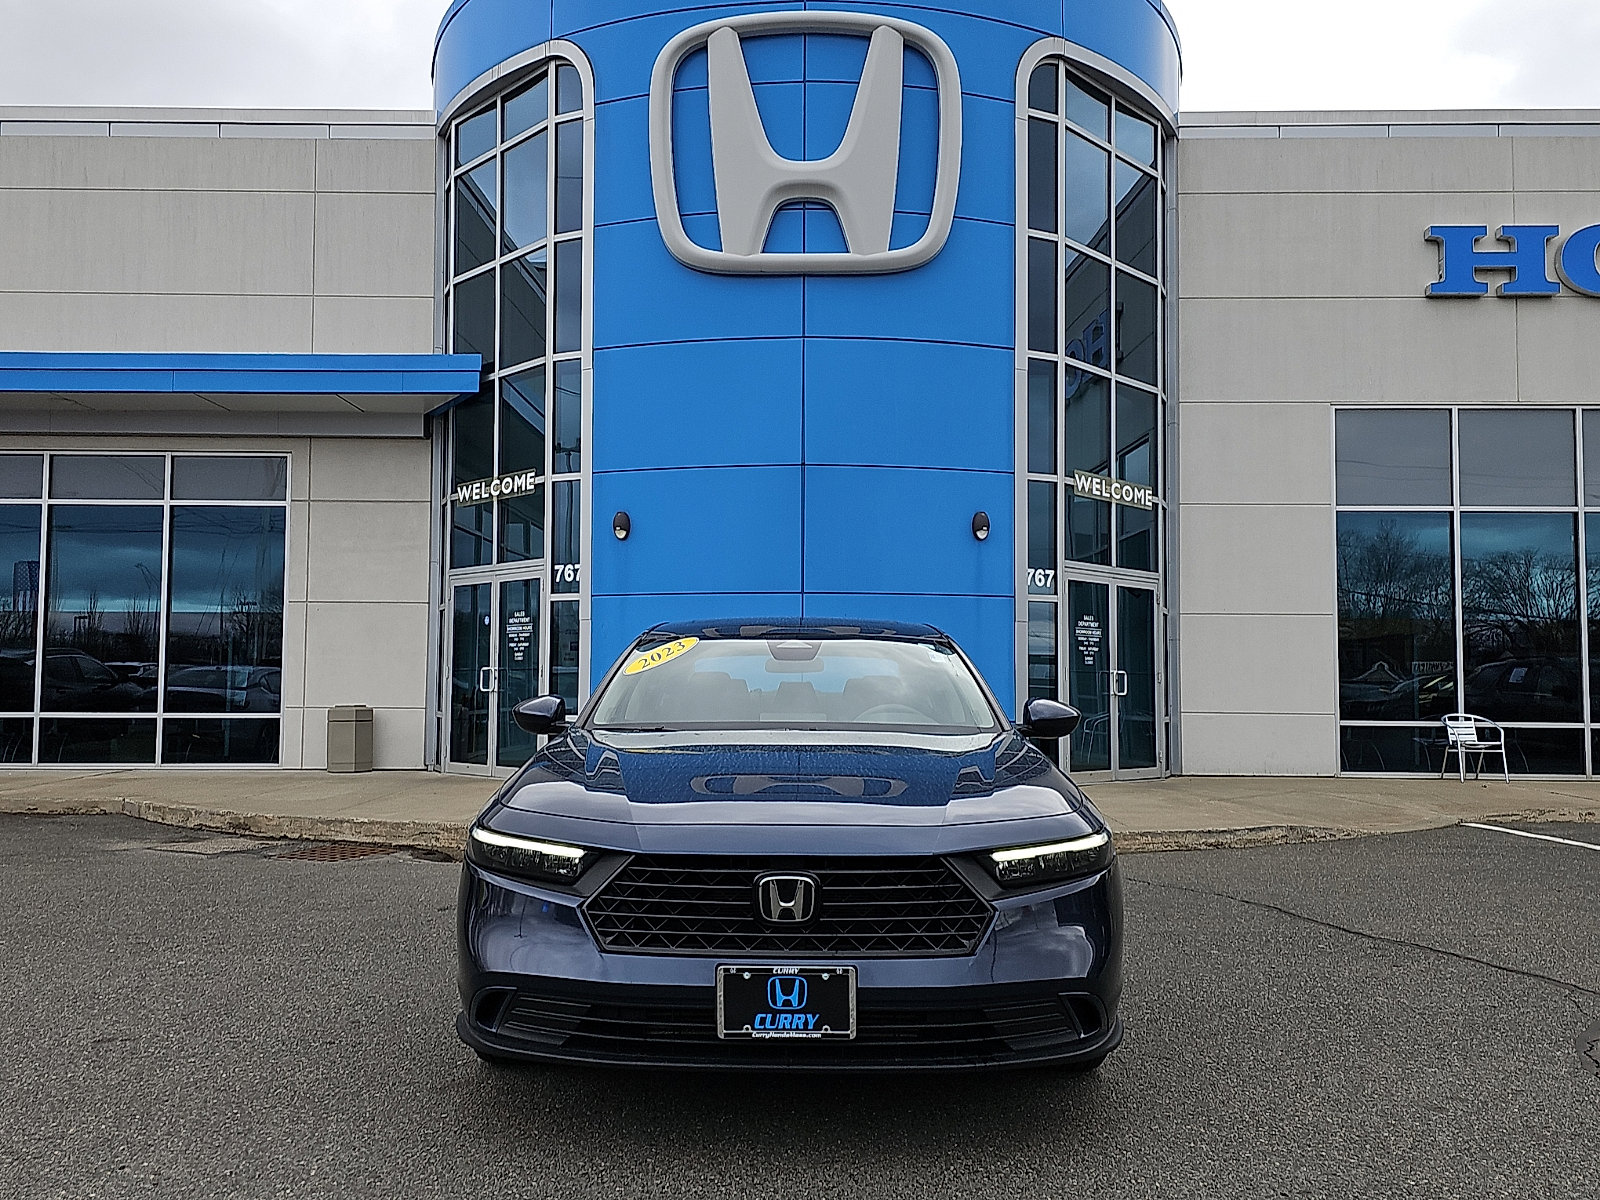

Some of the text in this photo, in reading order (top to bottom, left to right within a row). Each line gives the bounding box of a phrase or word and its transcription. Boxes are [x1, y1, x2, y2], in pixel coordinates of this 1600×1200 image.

[457, 471, 536, 503] WELCOME
[1074, 473, 1153, 507] WELCOME
[1027, 568, 1055, 588] 767
[638, 641, 686, 670] 2023
[772, 967, 800, 975] CURRY
[754, 1013, 820, 1030] CURRY
